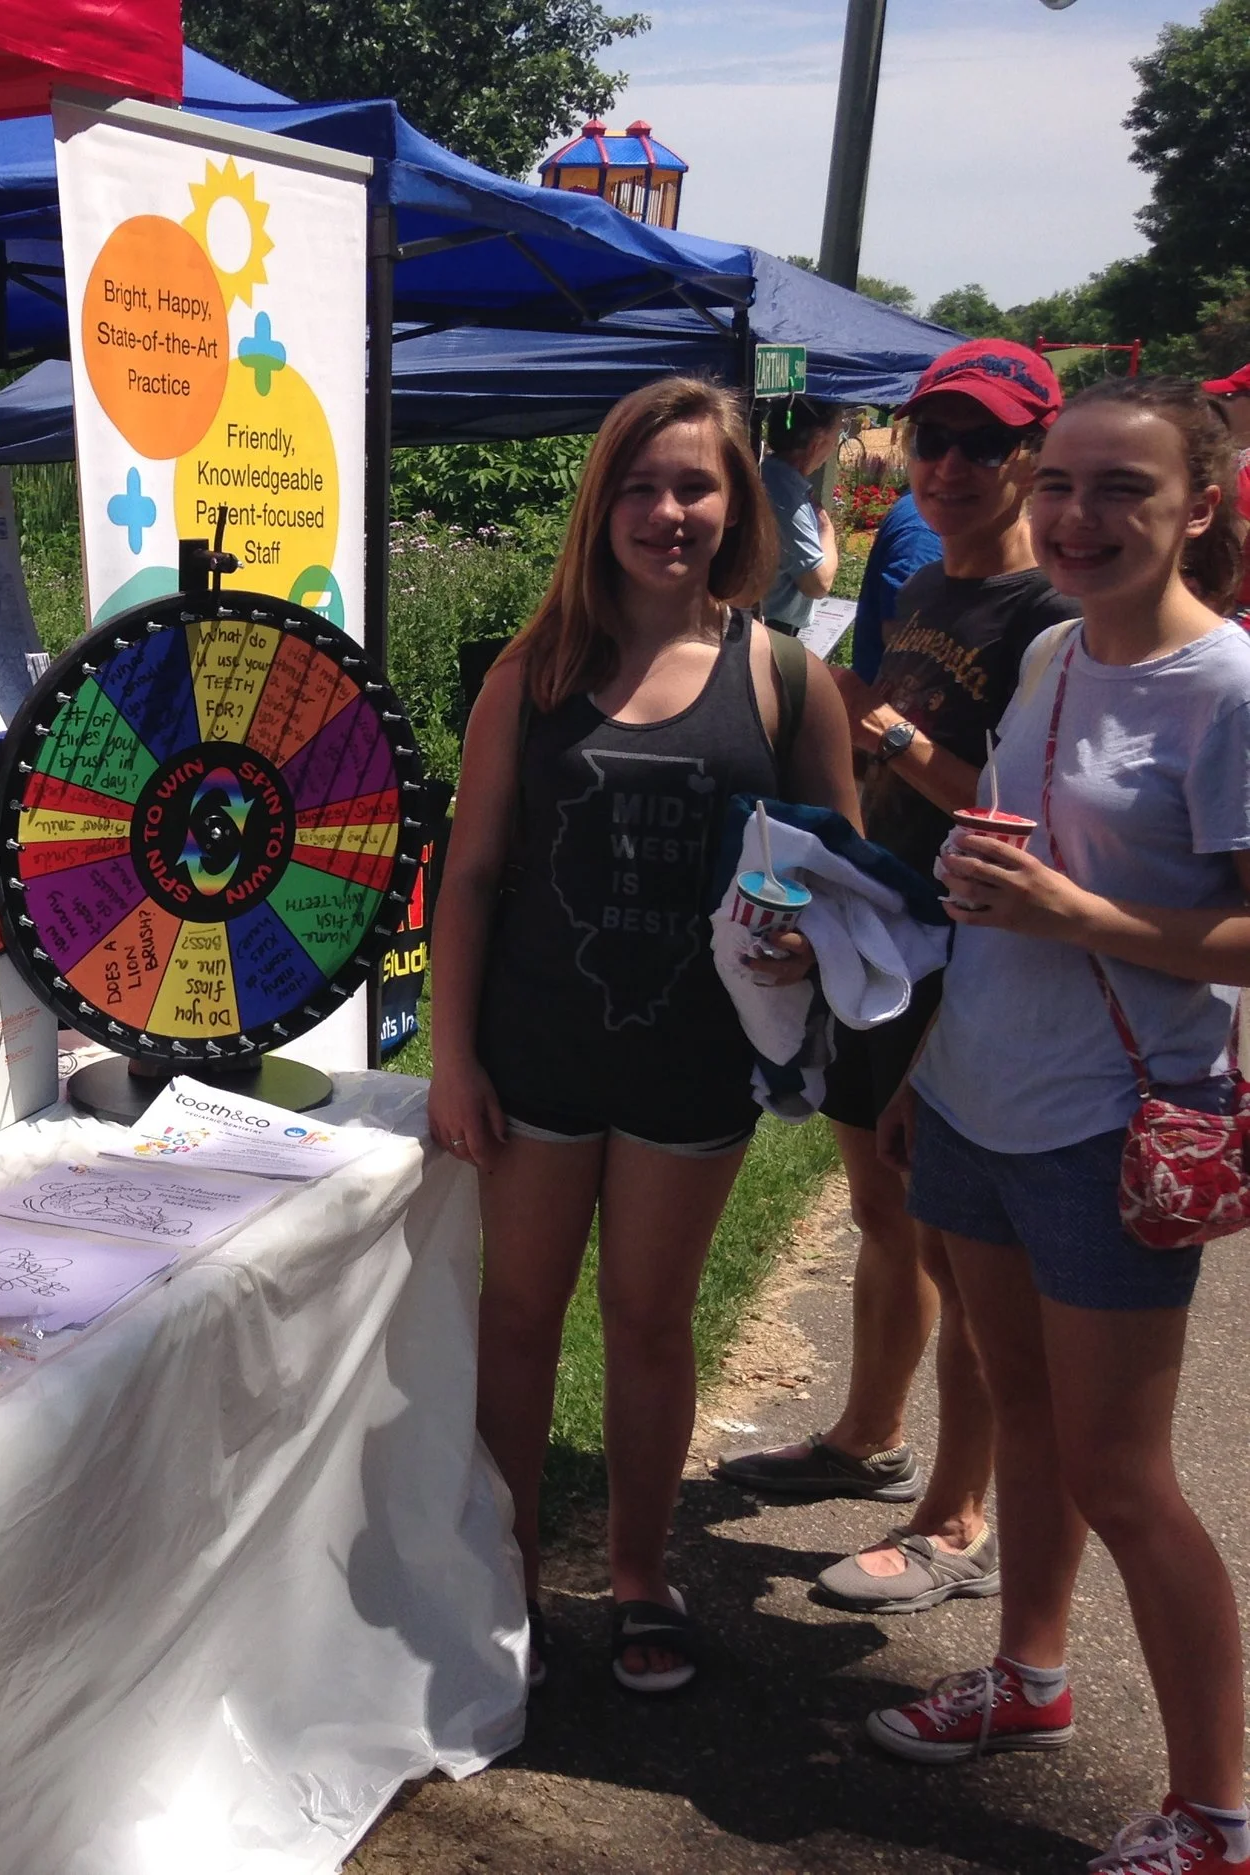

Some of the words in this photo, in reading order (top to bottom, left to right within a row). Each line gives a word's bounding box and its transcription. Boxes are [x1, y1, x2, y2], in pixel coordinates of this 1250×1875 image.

[104, 280, 152, 315] Bright,
[158, 290, 212, 322] Happy,
[97, 323, 218, 359] State-of-the-Art
[128, 369, 190, 397] Practice
[227, 424, 295, 457] Friendly,
[197, 461, 323, 496] Knowledgeable
[244, 540, 281, 566] Staff
[200, 627, 242, 645] What
[250, 631, 267, 649] do
[217, 655, 240, 668] use
[245, 658, 271, 674] your
[203, 675, 254, 693] TEETH
[92, 713, 112, 728] of
[206, 701, 244, 725] FOR?
[60, 752, 110, 769] brush
[119, 754, 134, 770] in
[106, 736, 138, 757] you
[156, 758, 204, 799] WIN
[239, 762, 283, 815] SPIN
[144, 805, 163, 842] TO
[611, 792, 703, 828] MID-
[266, 821, 285, 858] TO
[610, 833, 700, 864] WEST
[146, 849, 192, 903] SPIN
[226, 865, 271, 904] WIN
[612, 871, 639, 896] IS
[285, 896, 332, 912] TEETH
[602, 905, 681, 936] BEST
[104, 940, 117, 951] A
[140, 910, 159, 972] BRUSH?
[106, 961, 122, 1005] DOES
[126, 946, 142, 990] LION
[186, 978, 226, 1002] floss
[175, 999, 203, 1025] you
[174, 1092, 271, 1130] tooth&co
